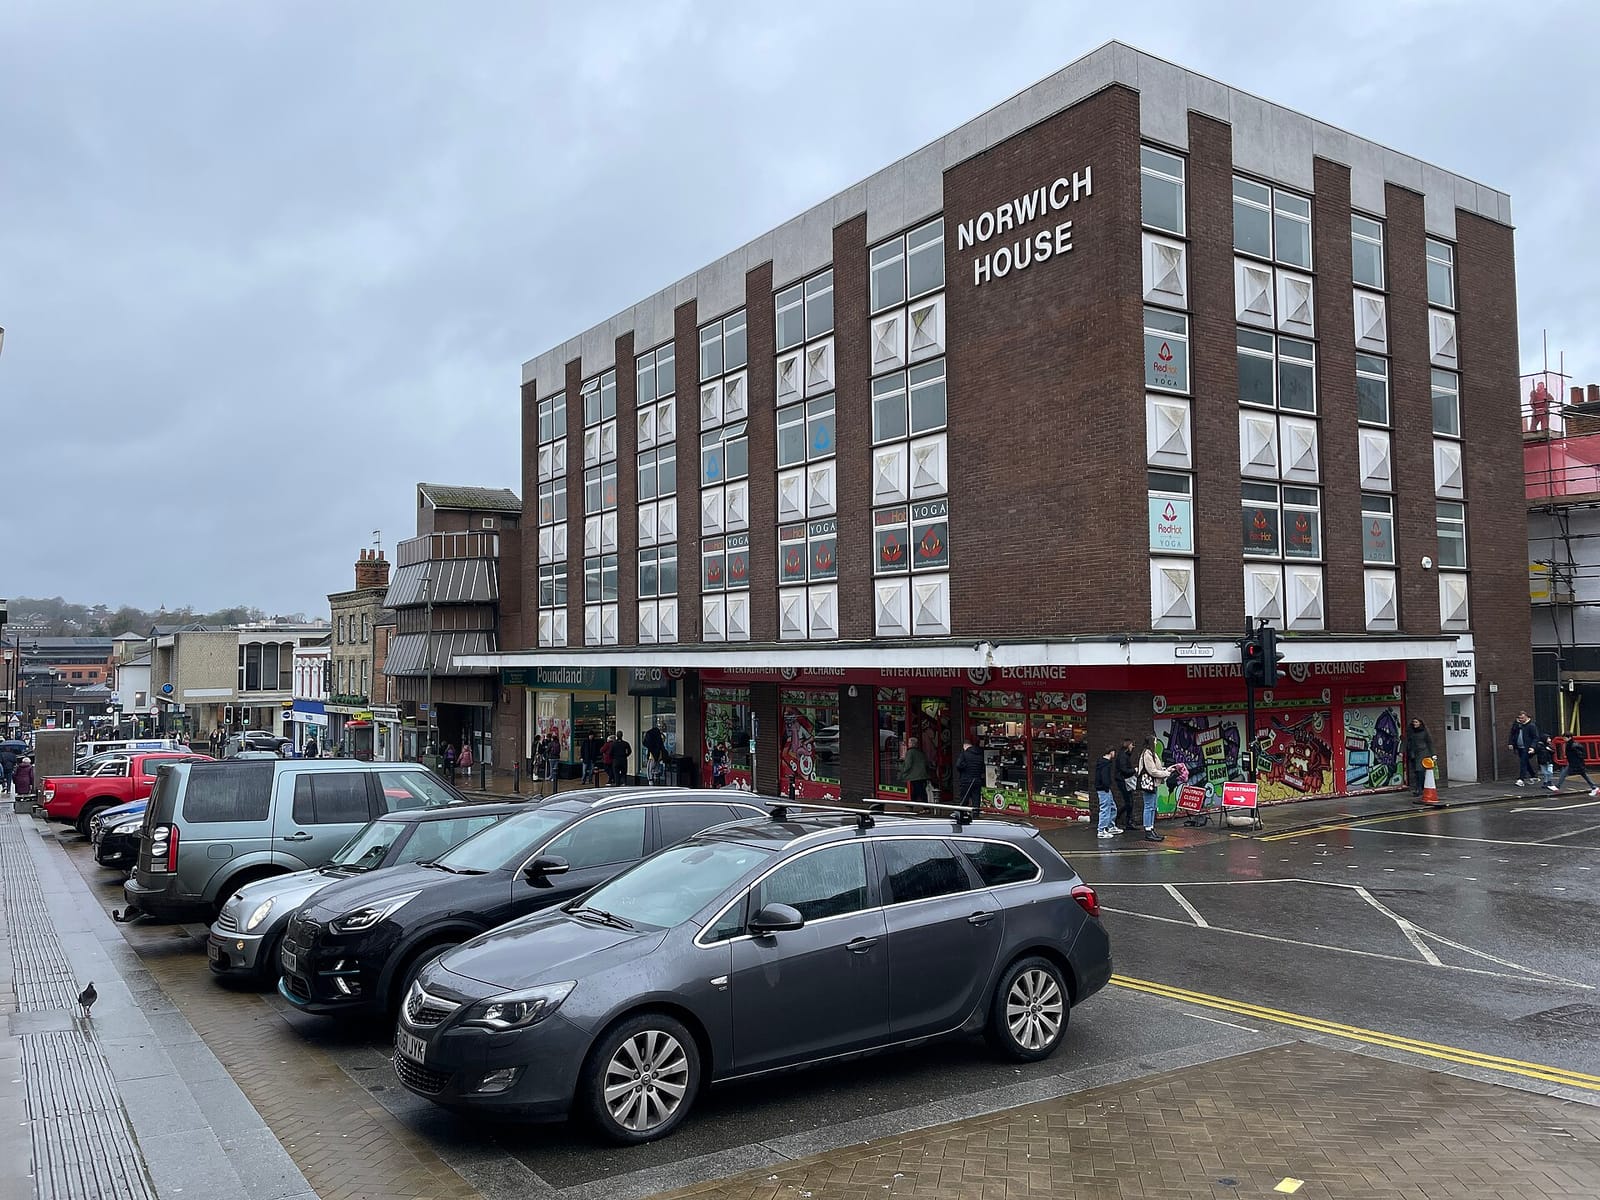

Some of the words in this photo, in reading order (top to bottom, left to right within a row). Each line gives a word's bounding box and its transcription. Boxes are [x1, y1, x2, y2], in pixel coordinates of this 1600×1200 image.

[957, 165, 1092, 250] NORWICH
[974, 221, 1074, 286] HOUSE
[1153, 361, 1178, 375] RedHot
[1155, 378, 1178, 387] YOGA
[913, 503, 946, 518] YOGA
[810, 523, 836, 535] YOGA
[1158, 523, 1183, 535] RedHot
[728, 536, 748, 546] YOGA
[1160, 540, 1182, 548] YOGA
[1314, 662, 1365, 675] EXCHANGE
[1446, 660, 1472, 668] NORWICH
[537, 667, 582, 684] Poundland
[803, 667, 846, 676] EXCHANGE
[880, 667, 961, 678] ENTERTAINMENT
[1001, 666, 1067, 680] EXCHANGE
[1450, 669, 1469, 677] HOUSE
[1208, 766, 1227, 781] CASH
